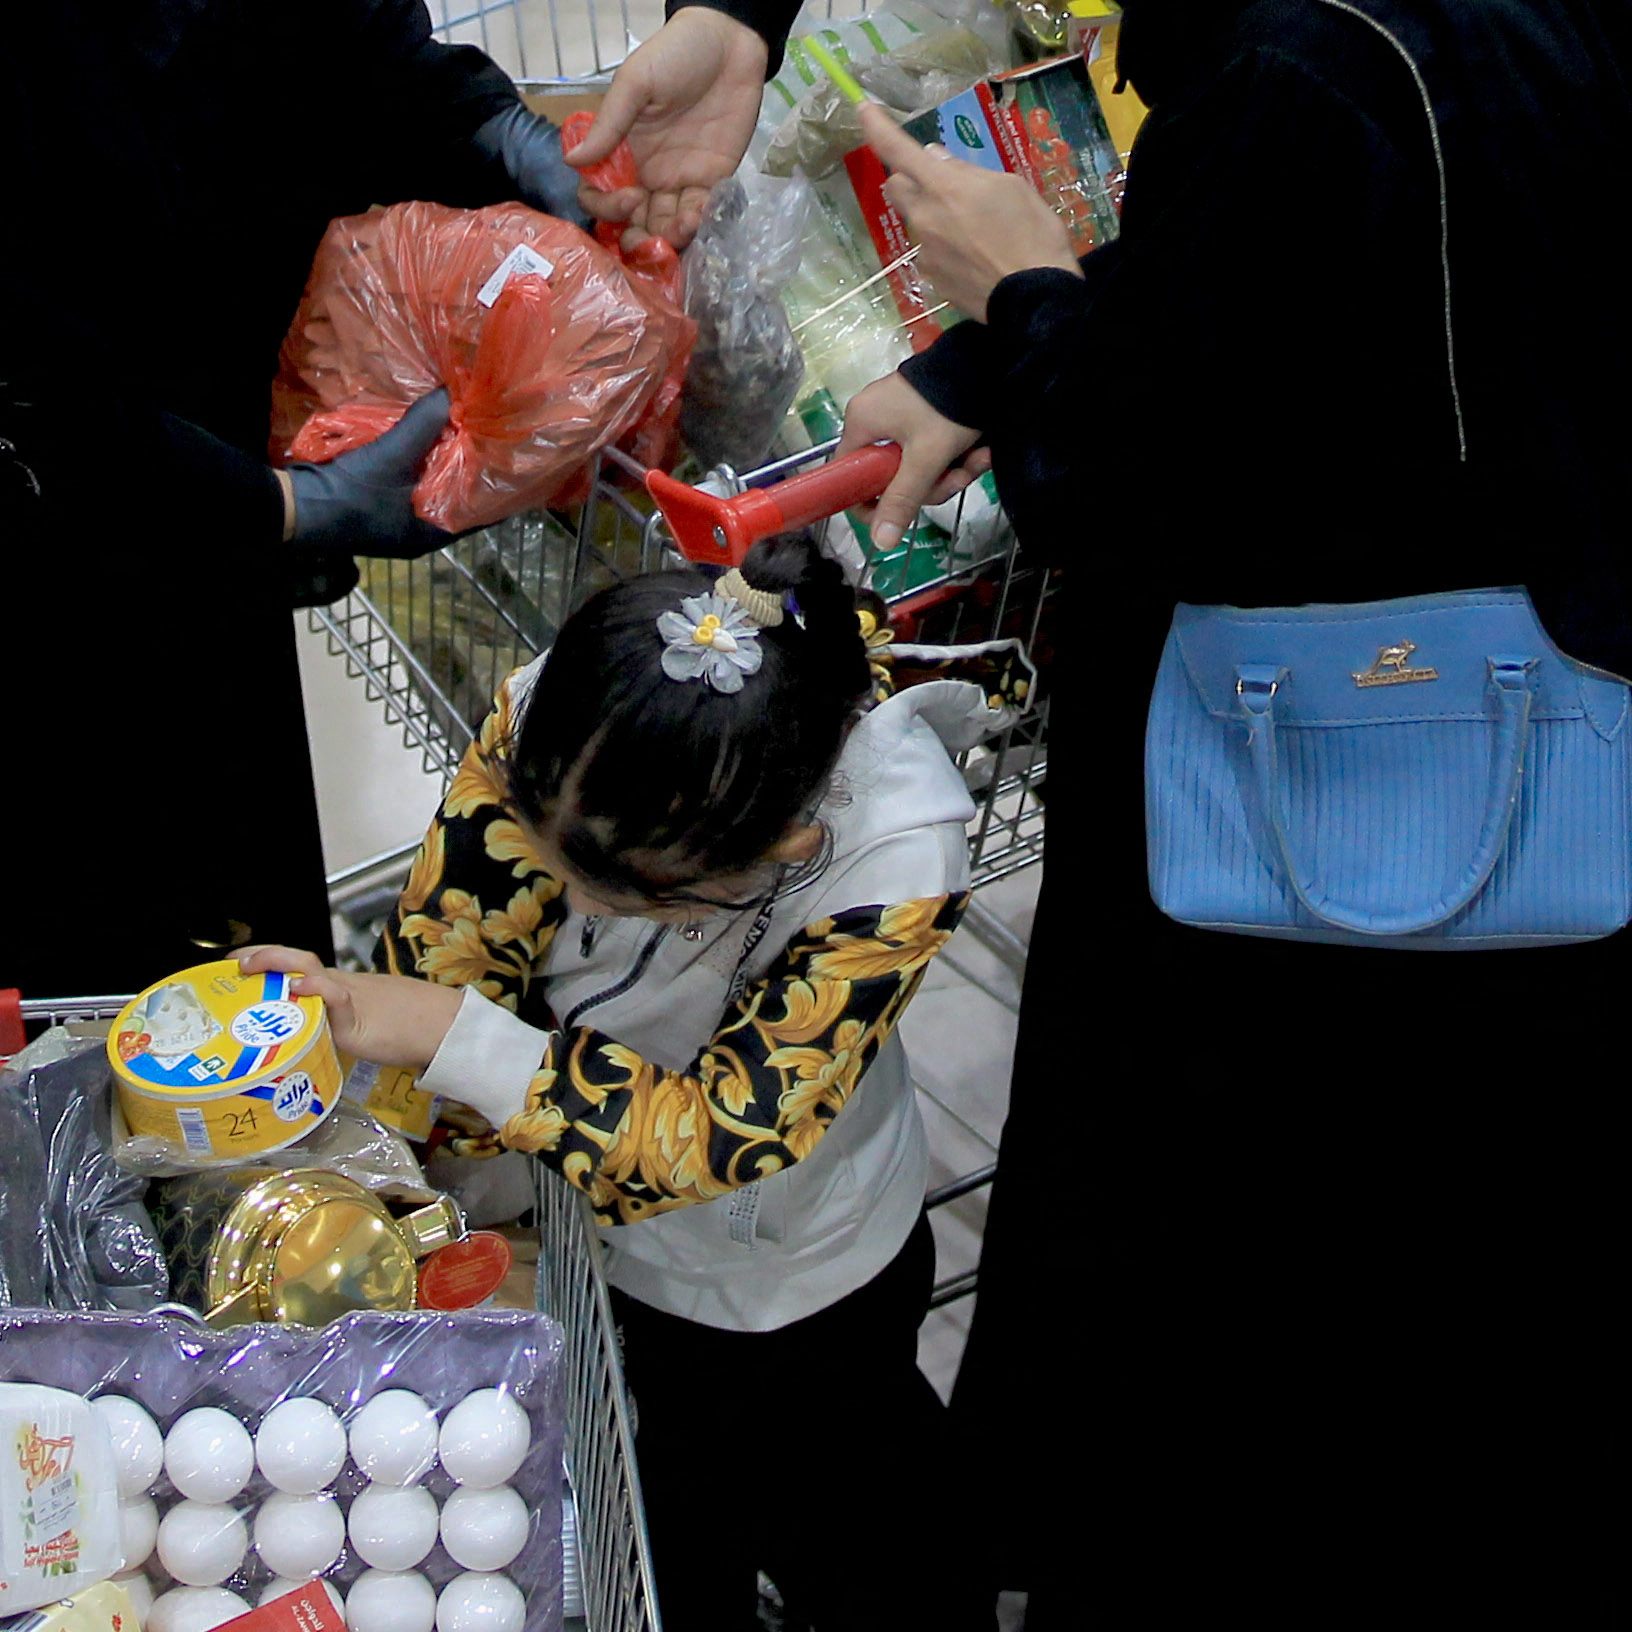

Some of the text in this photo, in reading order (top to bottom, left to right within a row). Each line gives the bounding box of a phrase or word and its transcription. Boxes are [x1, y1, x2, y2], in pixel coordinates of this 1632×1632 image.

[235, 1023, 260, 1043] Pride
[248, 1010, 293, 1041] برايد
[277, 1078, 309, 1110] برايد
[223, 1108, 258, 1137] 24
[289, 1100, 308, 1118] Pride
